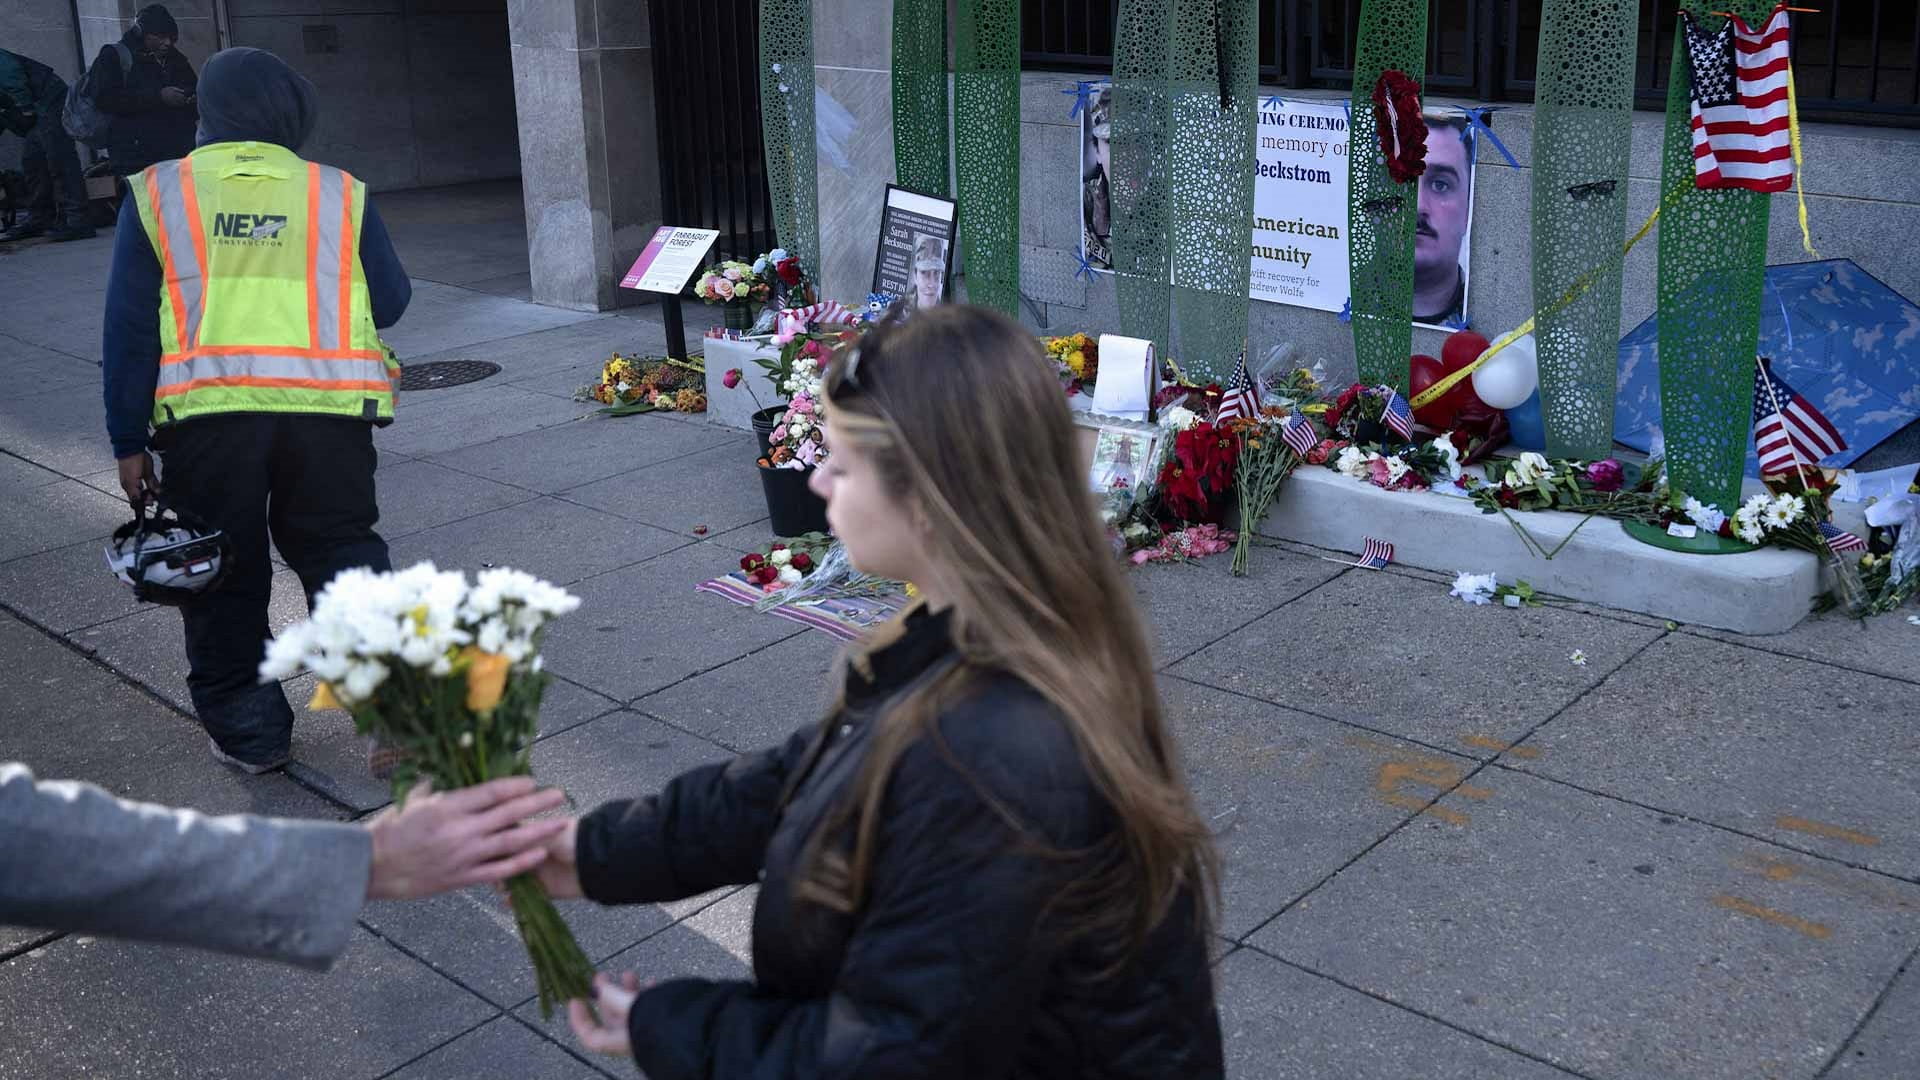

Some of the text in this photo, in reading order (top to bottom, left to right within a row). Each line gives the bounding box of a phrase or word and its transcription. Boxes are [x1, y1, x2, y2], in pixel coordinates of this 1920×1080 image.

[1262, 136, 1350, 158] memory of
[213, 212, 288, 239] NEXT
[890, 226, 909, 239] Sarah
[669, 238, 695, 247] FOREST
[674, 231, 709, 240] FARRAGUT
[884, 236, 913, 252] Beckstrom
[882, 279, 906, 293] REST IN
[1268, 273, 1305, 287] recovery
[1307, 276, 1320, 287] for
[1280, 285, 1304, 298] Wolfe
